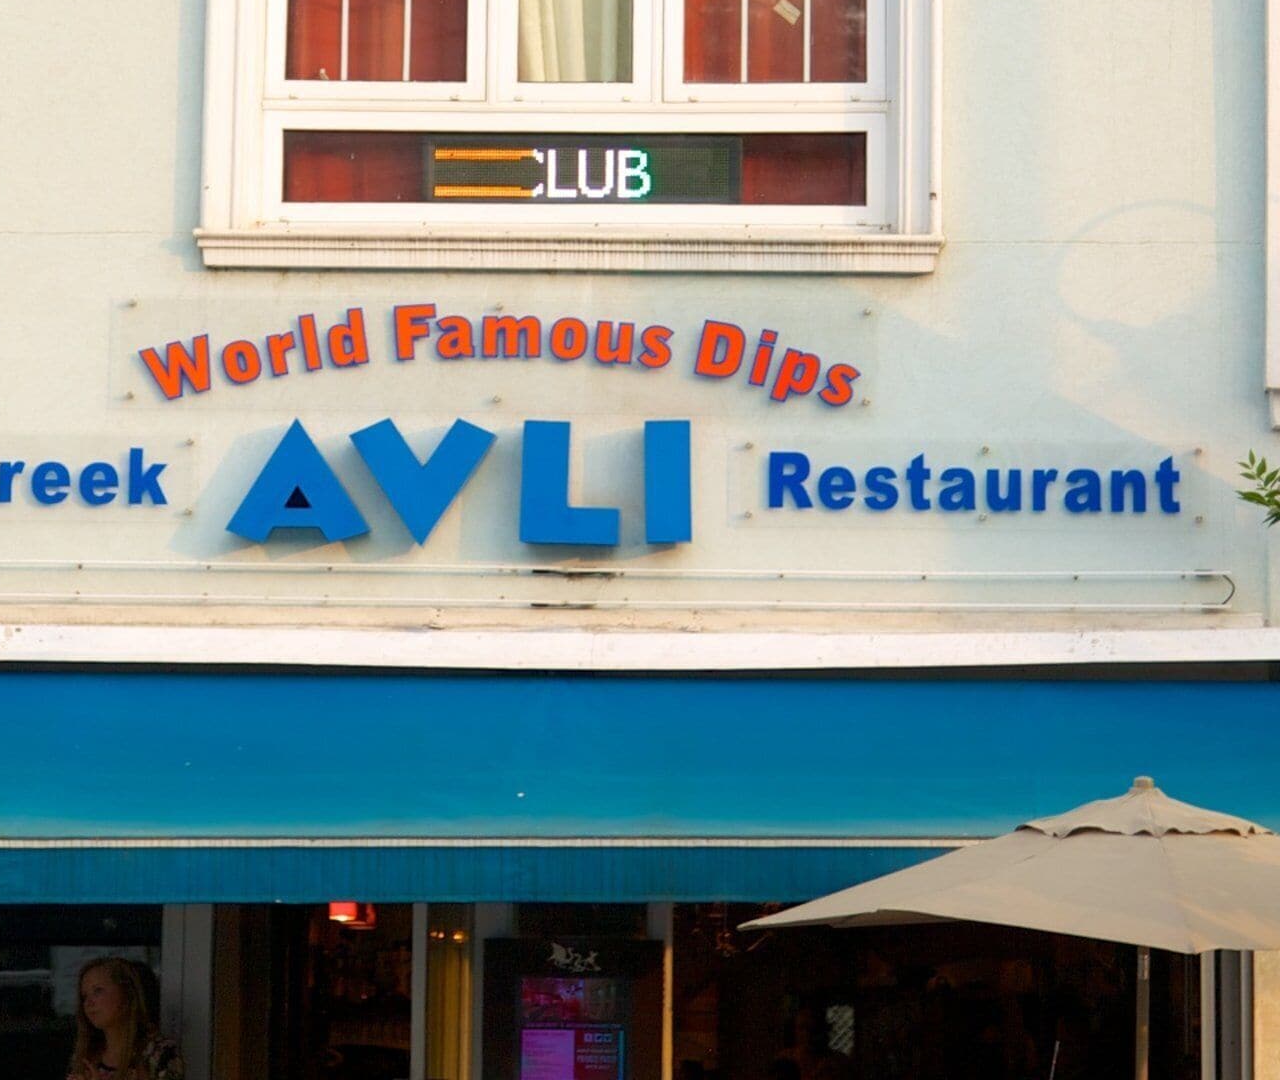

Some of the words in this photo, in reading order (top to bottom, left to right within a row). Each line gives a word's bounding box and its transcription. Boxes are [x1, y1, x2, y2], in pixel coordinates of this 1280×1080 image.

[138, 307, 370, 400] World
[393, 304, 674, 369] Famous
[694, 319, 860, 406] Dips
[225, 417, 692, 549] AVLI
[767, 451, 1181, 514] Restaurant
